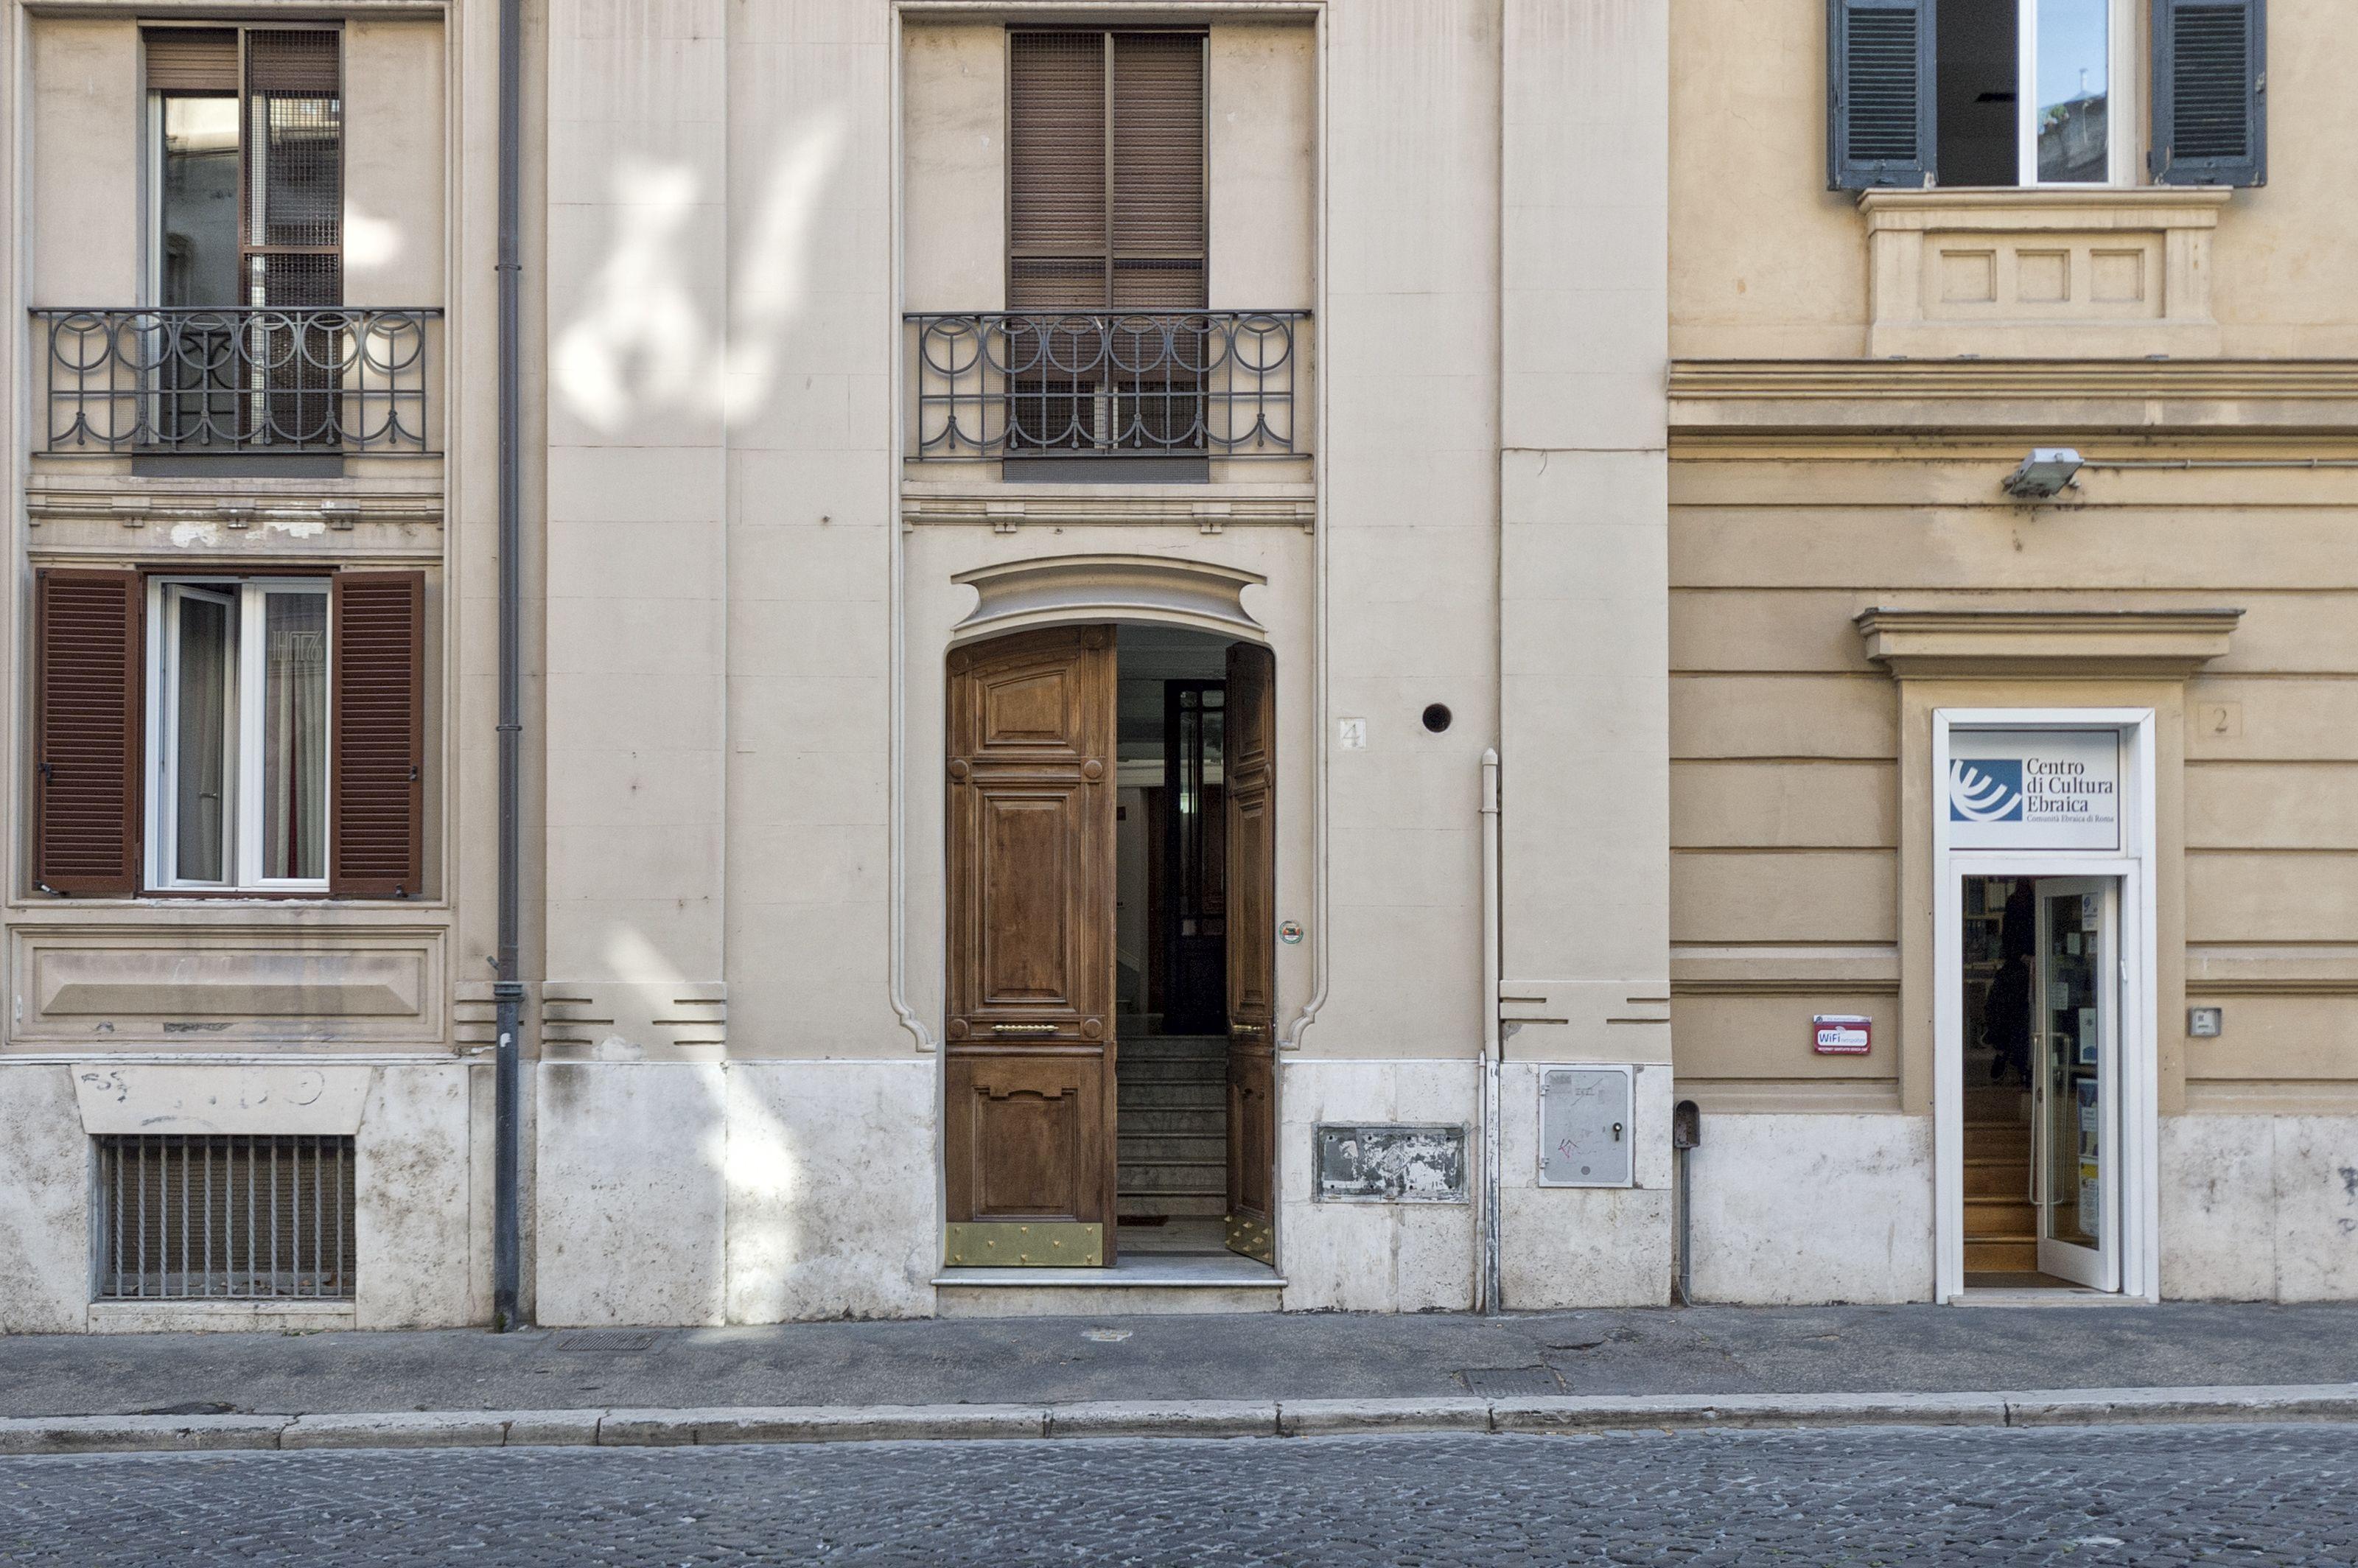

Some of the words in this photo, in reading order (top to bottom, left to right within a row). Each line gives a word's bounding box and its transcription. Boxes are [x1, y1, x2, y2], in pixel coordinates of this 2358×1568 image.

[2213, 707, 2228, 733] 2
[1343, 723, 1360, 747] 4
[2026, 757, 2085, 775] Centro
[2027, 777, 2043, 794] di
[2049, 777, 2113, 794] Cultura
[2028, 795, 2088, 812] Ebraica
[2026, 814, 2060, 822] Comunità
[2061, 814, 2085, 822] Ebraica
[2086, 814, 2093, 822] di
[2095, 814, 2114, 822] Roma
[1819, 1032, 1841, 1043] WiFi
